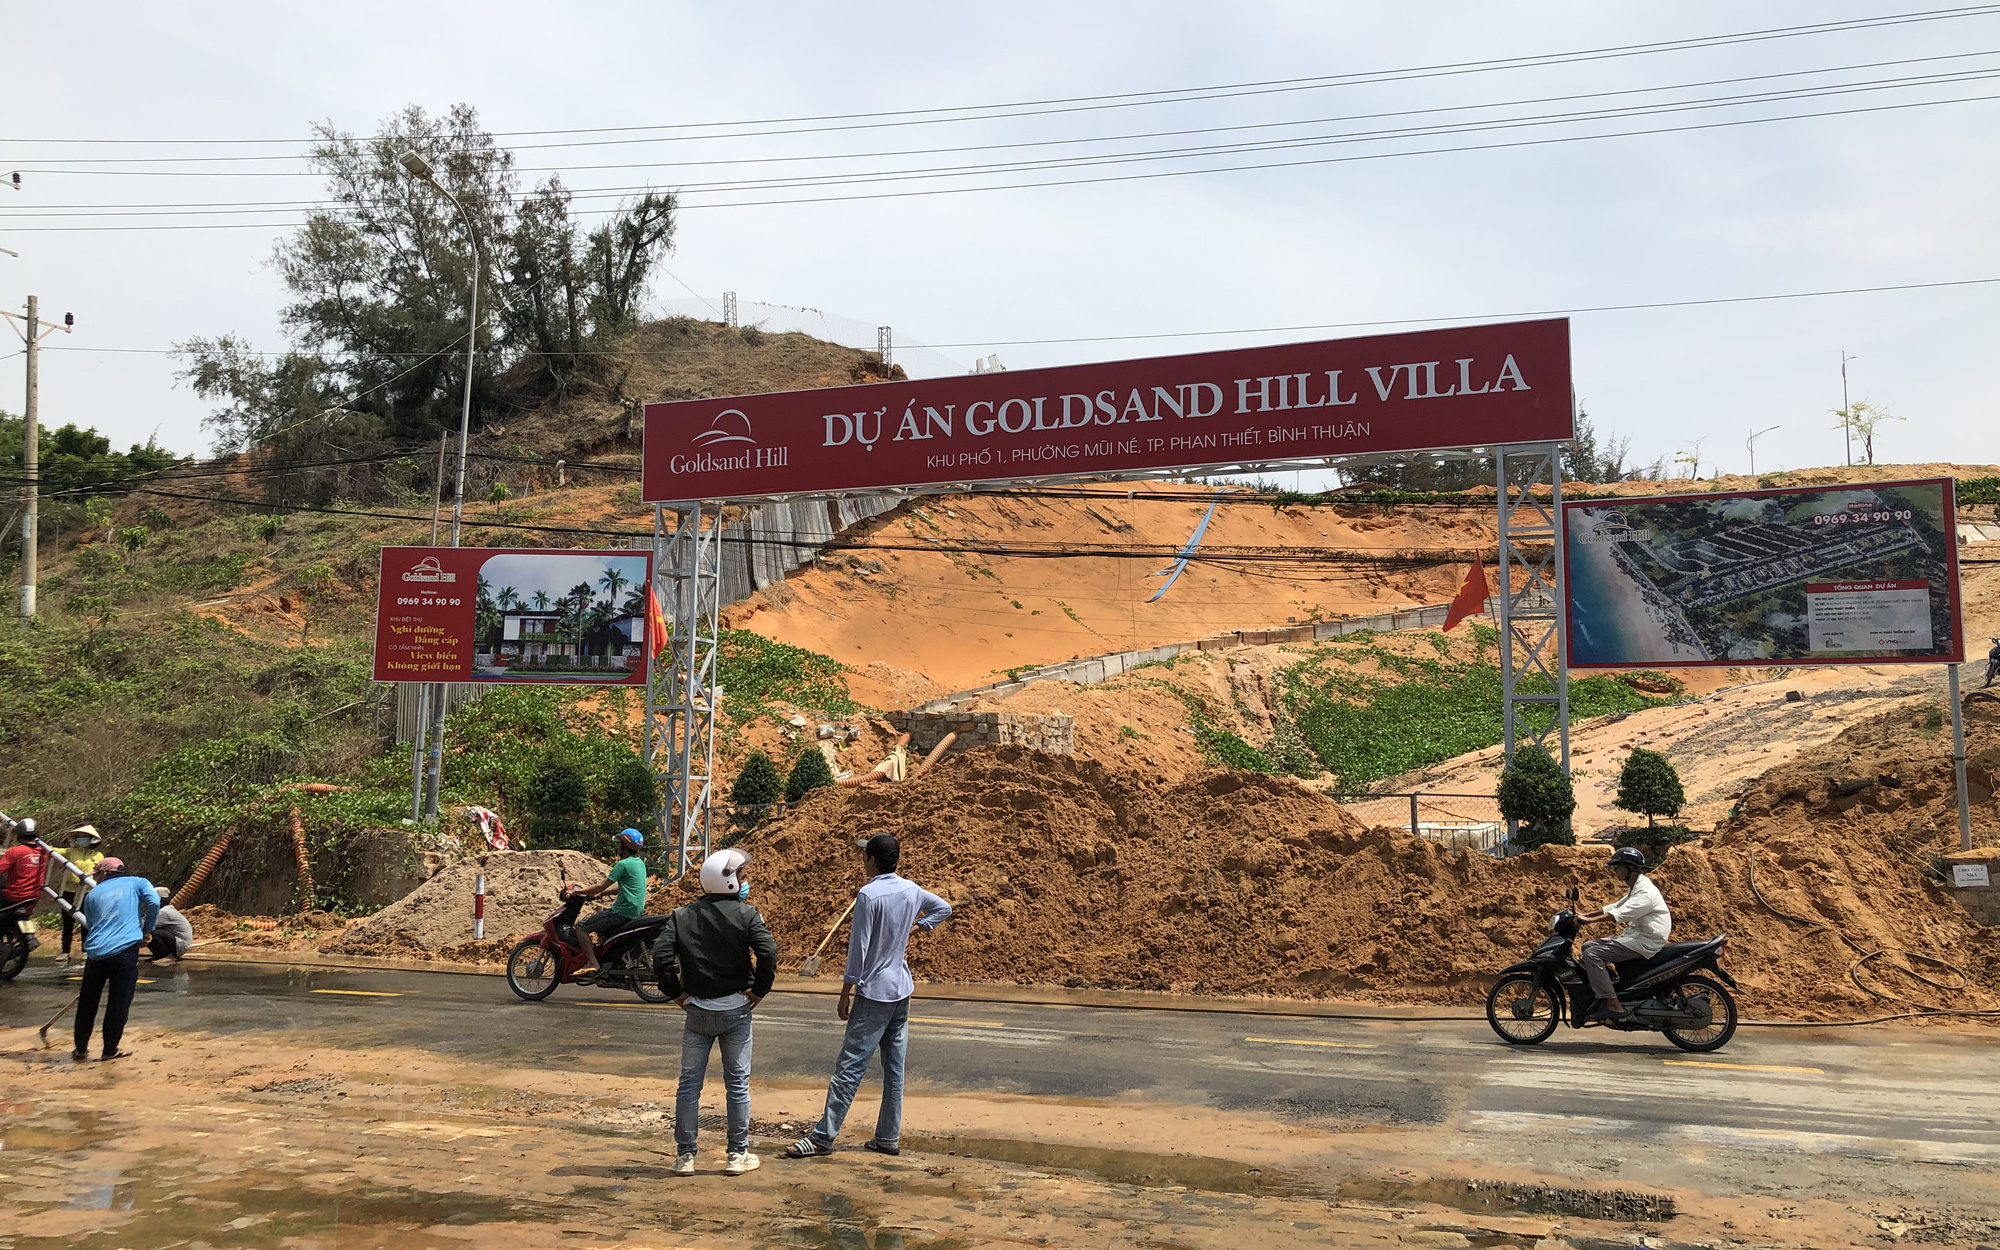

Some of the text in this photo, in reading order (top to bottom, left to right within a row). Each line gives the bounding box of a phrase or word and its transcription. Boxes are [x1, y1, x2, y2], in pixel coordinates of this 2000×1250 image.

[822, 354, 1531, 451] DỰ ÁN GOLDSAND HILL VILLA
[927, 454, 955, 468] KHU
[959, 448, 991, 465] PHỐ
[1012, 443, 1080, 463] PHƯỜNG
[1084, 440, 1113, 457] MŨI
[1118, 437, 1142, 455] NÉ,
[1147, 438, 1166, 451] TP.
[1170, 434, 1216, 450] PHAN
[1221, 427, 1262, 446] THIẾT,
[1268, 426, 1307, 443] BÌNH
[1311, 420, 1371, 441] THUẬN
[670, 446, 789, 475] Goldsand Hill
[1848, 502, 1875, 510] Hotline:
[1814, 510, 1912, 526] 0969 34 90 90
[1579, 529, 1651, 545] Goldsand Hill
[401, 572, 456, 583] Goldsand Hill
[397, 597, 461, 606] 0969 34 90 90
[441, 635, 459, 646] cấp
[410, 651, 433, 660] View
[387, 661, 461, 672] Không giới hạn
